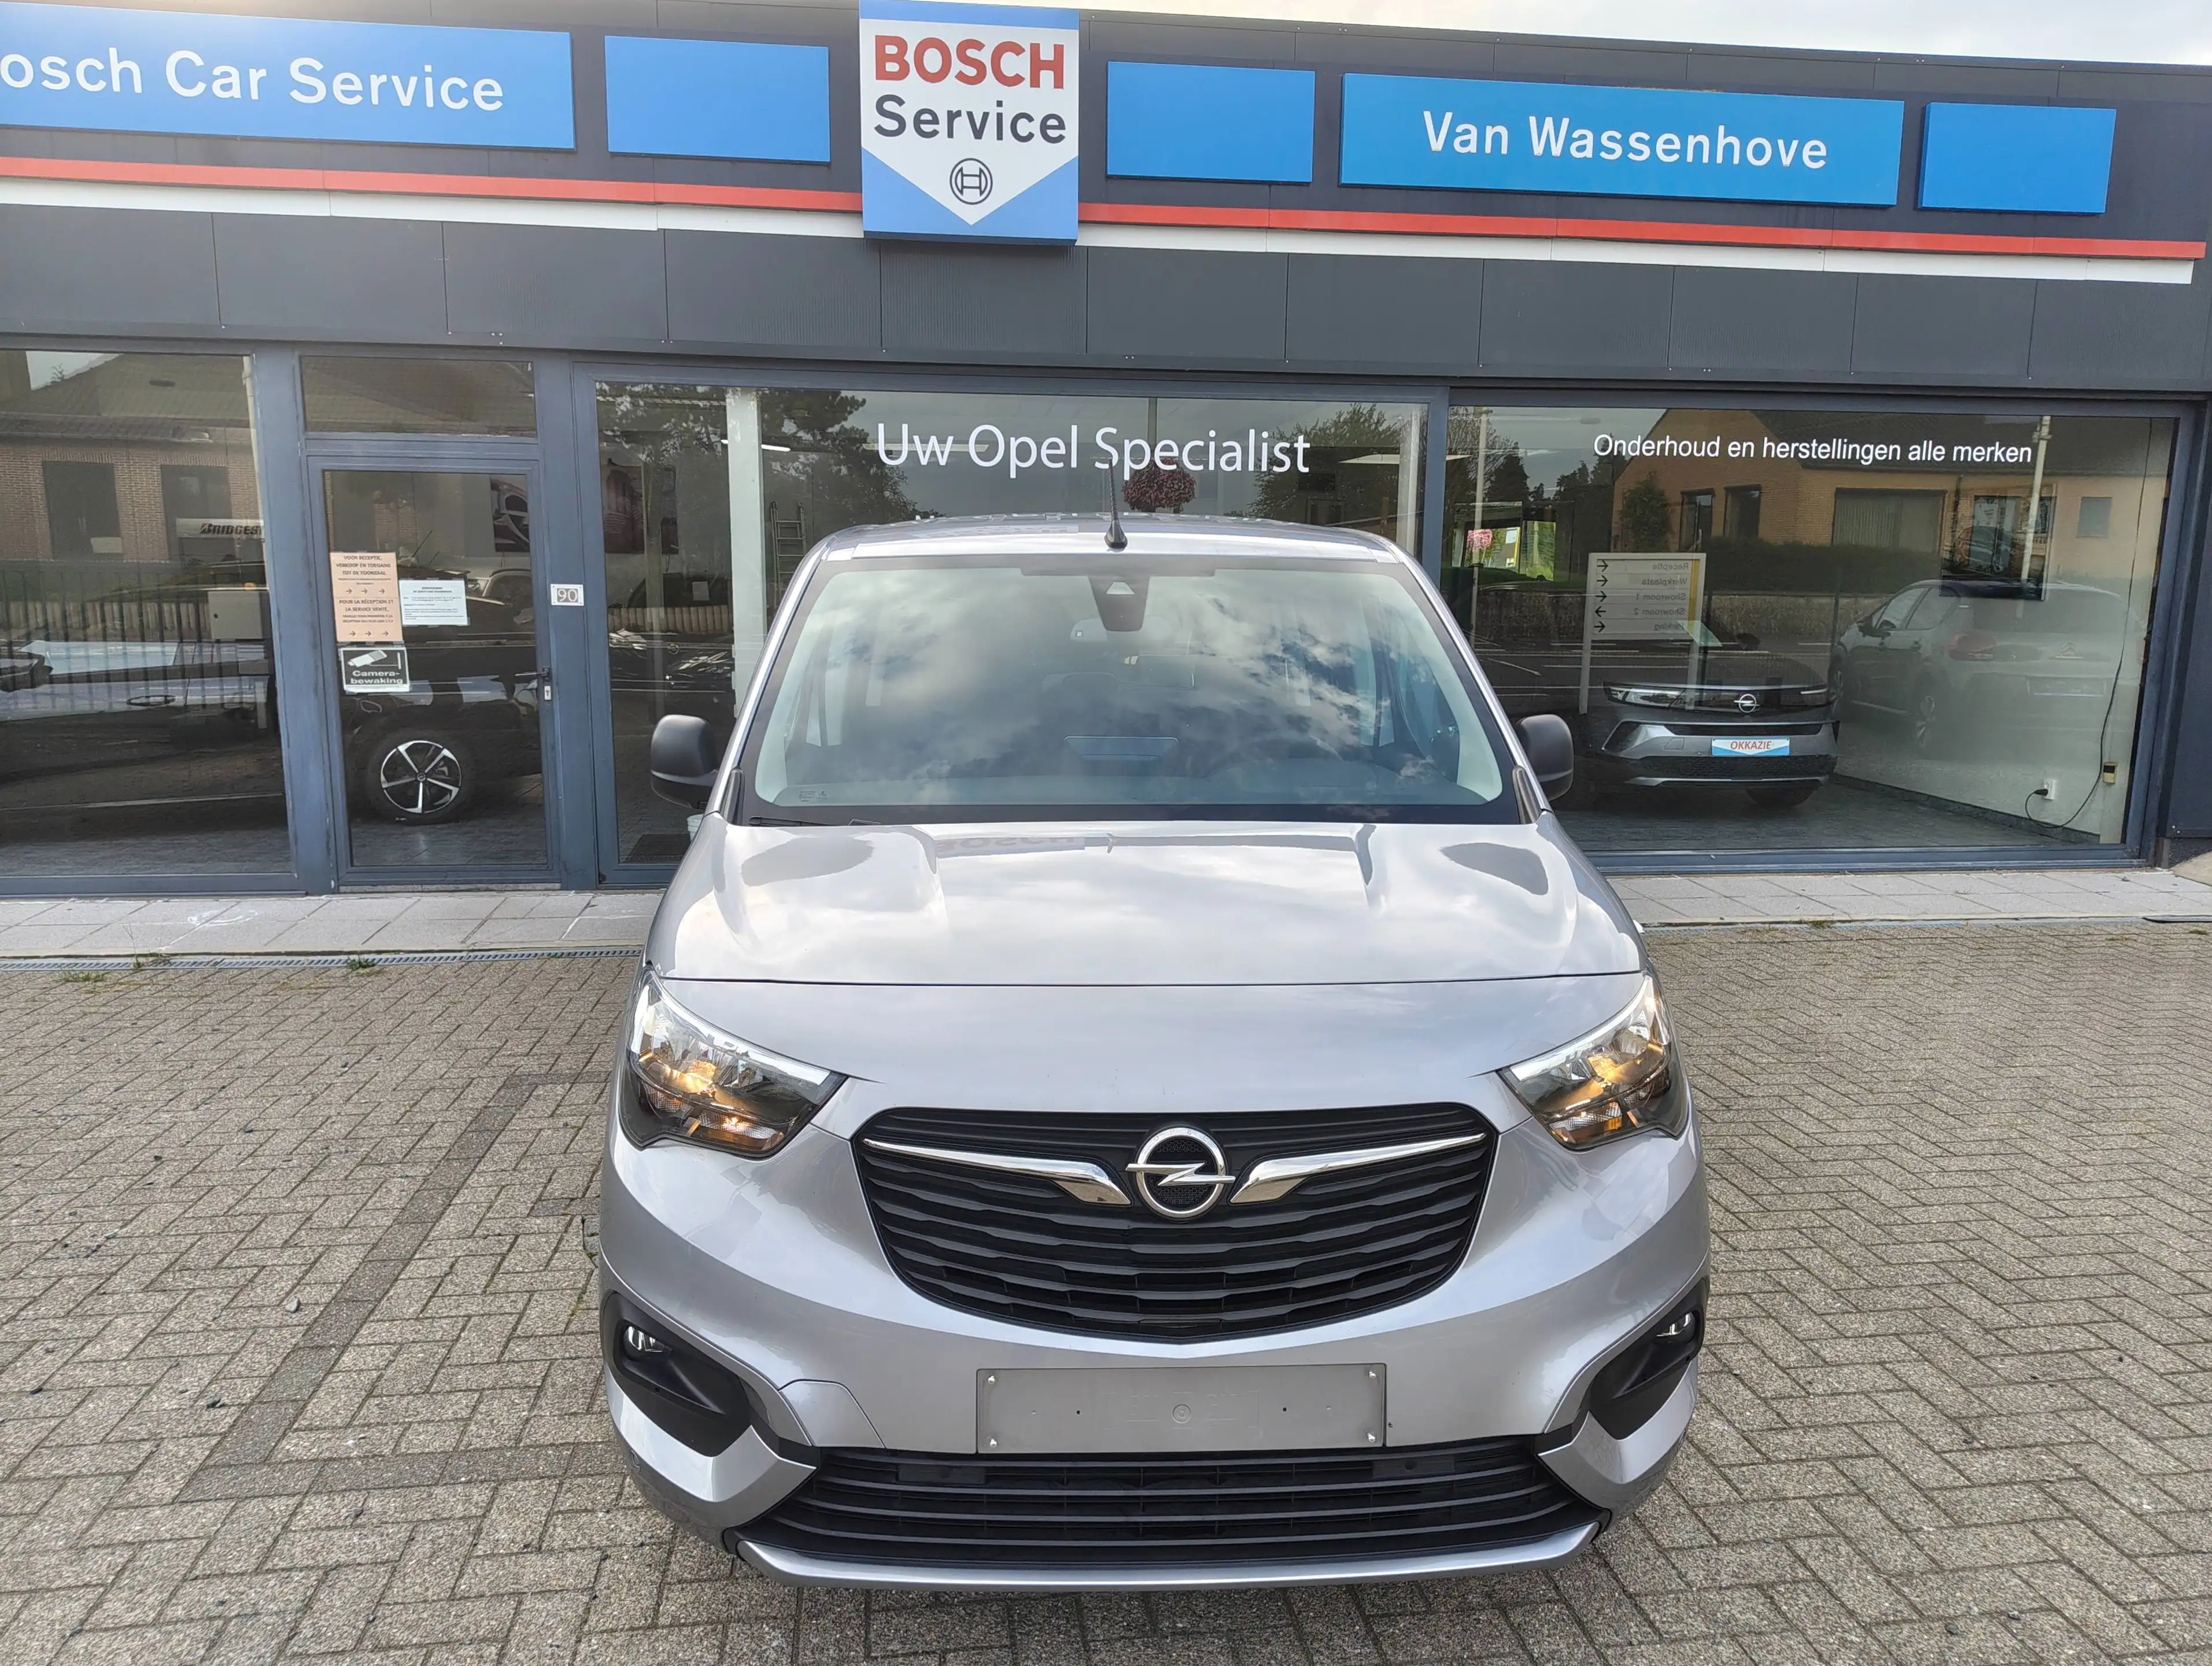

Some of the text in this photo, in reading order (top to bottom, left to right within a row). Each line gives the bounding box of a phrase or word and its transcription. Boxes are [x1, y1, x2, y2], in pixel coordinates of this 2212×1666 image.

[0, 47, 503, 110] osch Car Service
[874, 35, 1064, 90] BOSCH
[874, 94, 1066, 144] Service
[1423, 110, 1827, 169] Van Wassenhove
[877, 423, 1311, 481] Uw Opel Specialist
[1593, 433, 2032, 465] Onderhoud en herstellingen alle merken
[557, 588, 578, 602] 90
[1730, 740, 1772, 750] OKKAZIE
